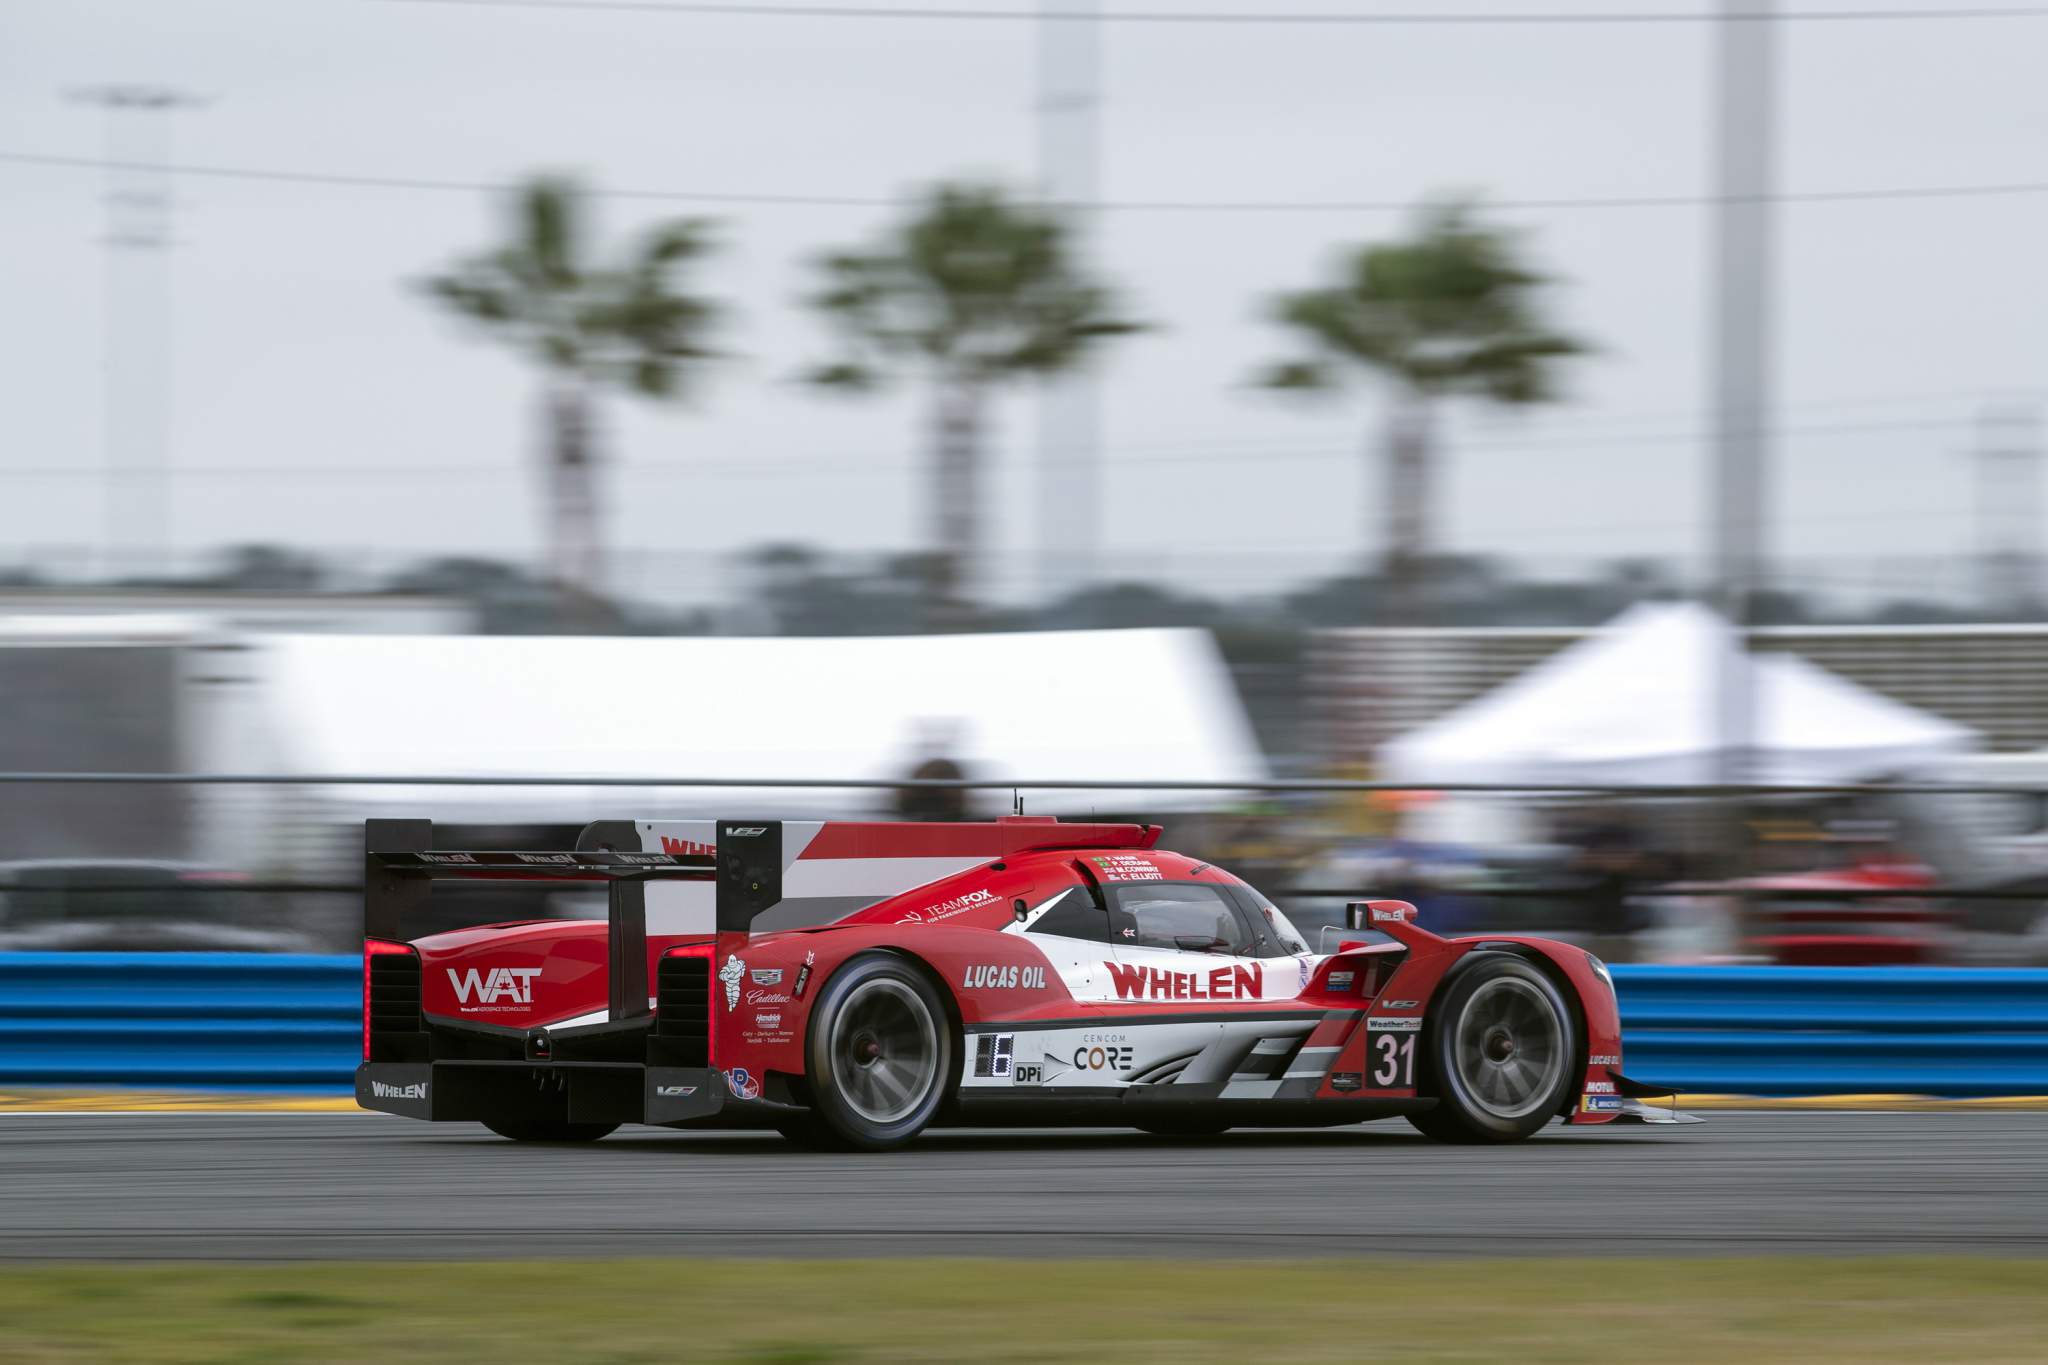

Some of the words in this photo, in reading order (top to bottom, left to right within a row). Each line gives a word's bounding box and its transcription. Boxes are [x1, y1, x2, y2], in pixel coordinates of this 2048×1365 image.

[615, 854, 679, 865] WHELEN
[1372, 908, 1406, 921] WHELEN
[446, 968, 543, 1003] WAT
[963, 966, 1019, 988] LUCAS
[1021, 966, 1047, 988] OIL
[1103, 961, 1262, 999] WHELEN
[746, 990, 791, 1005] Cadillac
[1083, 1035, 1126, 1043] CENCOM
[1074, 1047, 1133, 1070] CORE
[1374, 1034, 1415, 1086] 31
[1016, 1067, 1041, 1082] DPi
[371, 1080, 426, 1099] WHELEN
